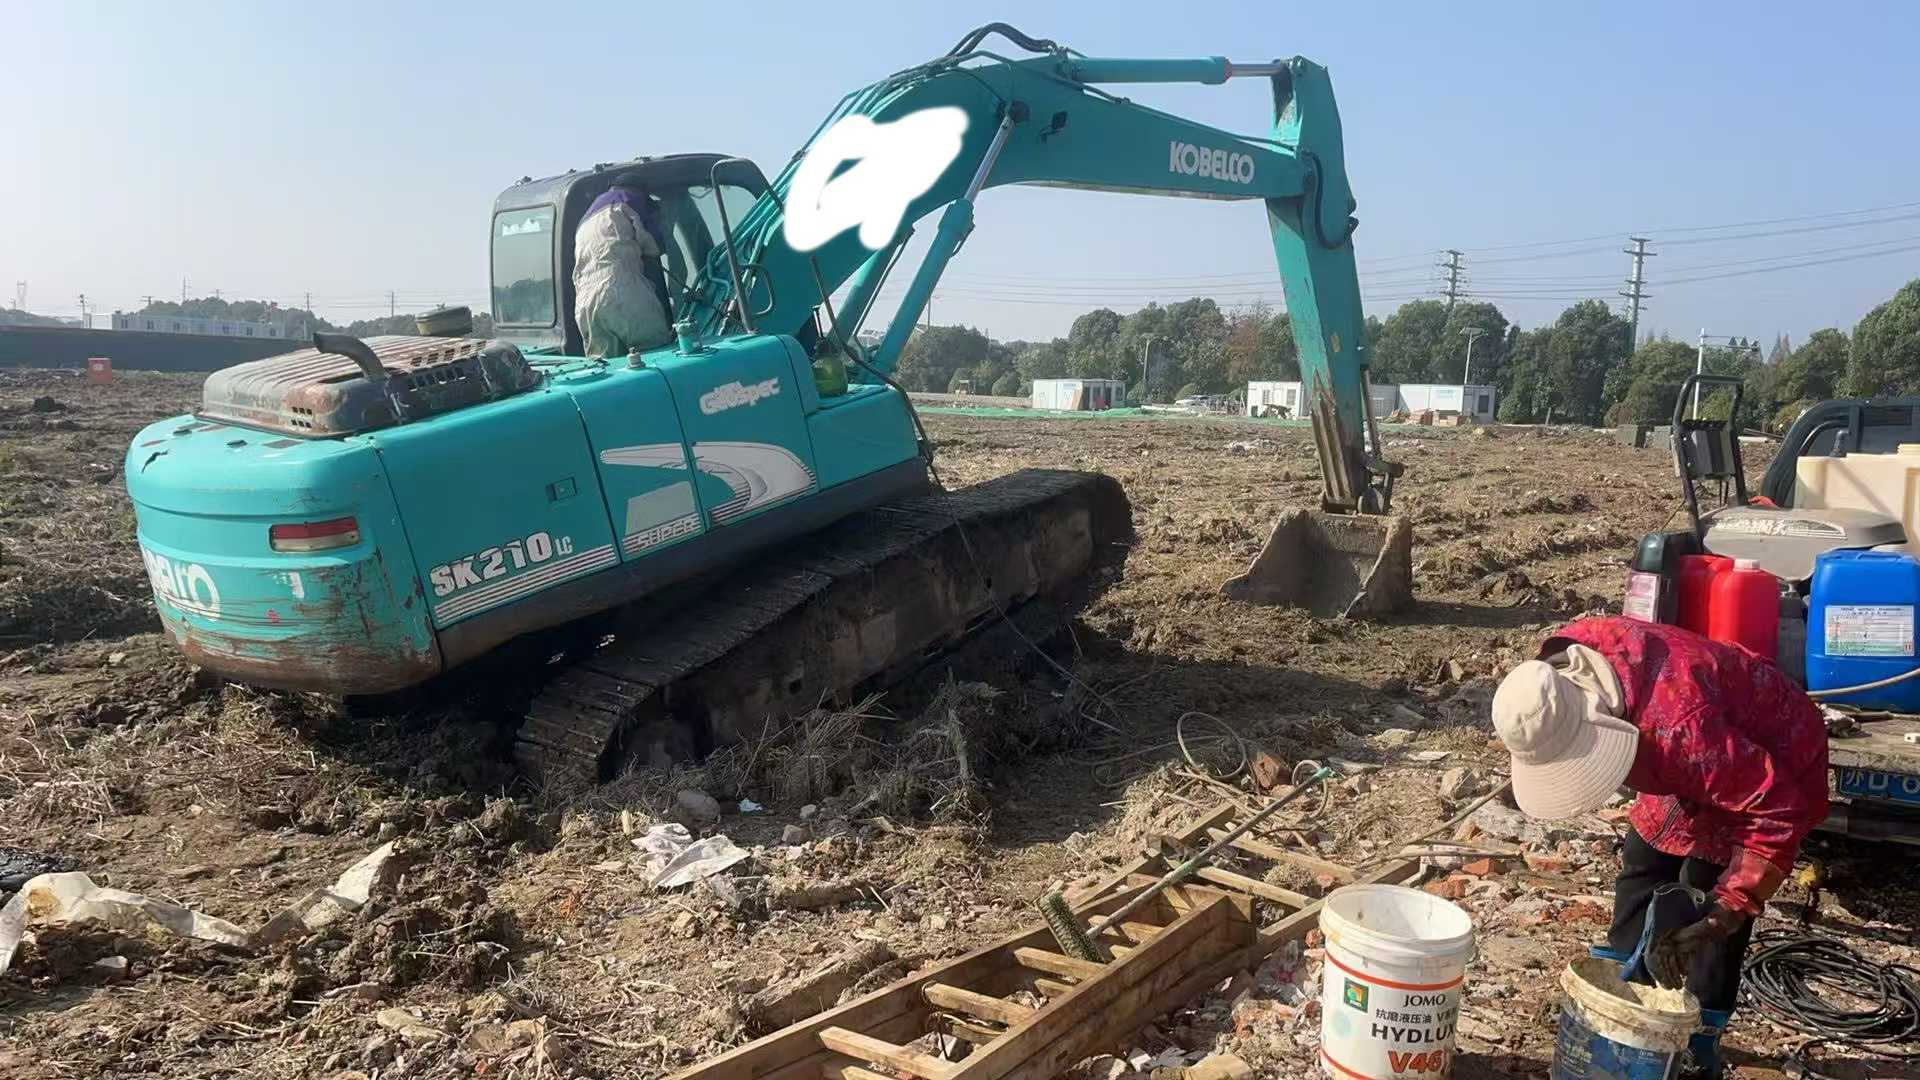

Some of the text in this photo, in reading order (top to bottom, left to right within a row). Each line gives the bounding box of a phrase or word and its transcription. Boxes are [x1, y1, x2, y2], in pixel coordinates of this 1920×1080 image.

[1169, 140, 1255, 184] KOBELCO
[429, 531, 574, 597] SK210 LC
[1403, 993, 1447, 1008] JOMO
[1375, 1007, 1433, 1024] 抗磨液压油
[1387, 1049, 1443, 1074] V46
